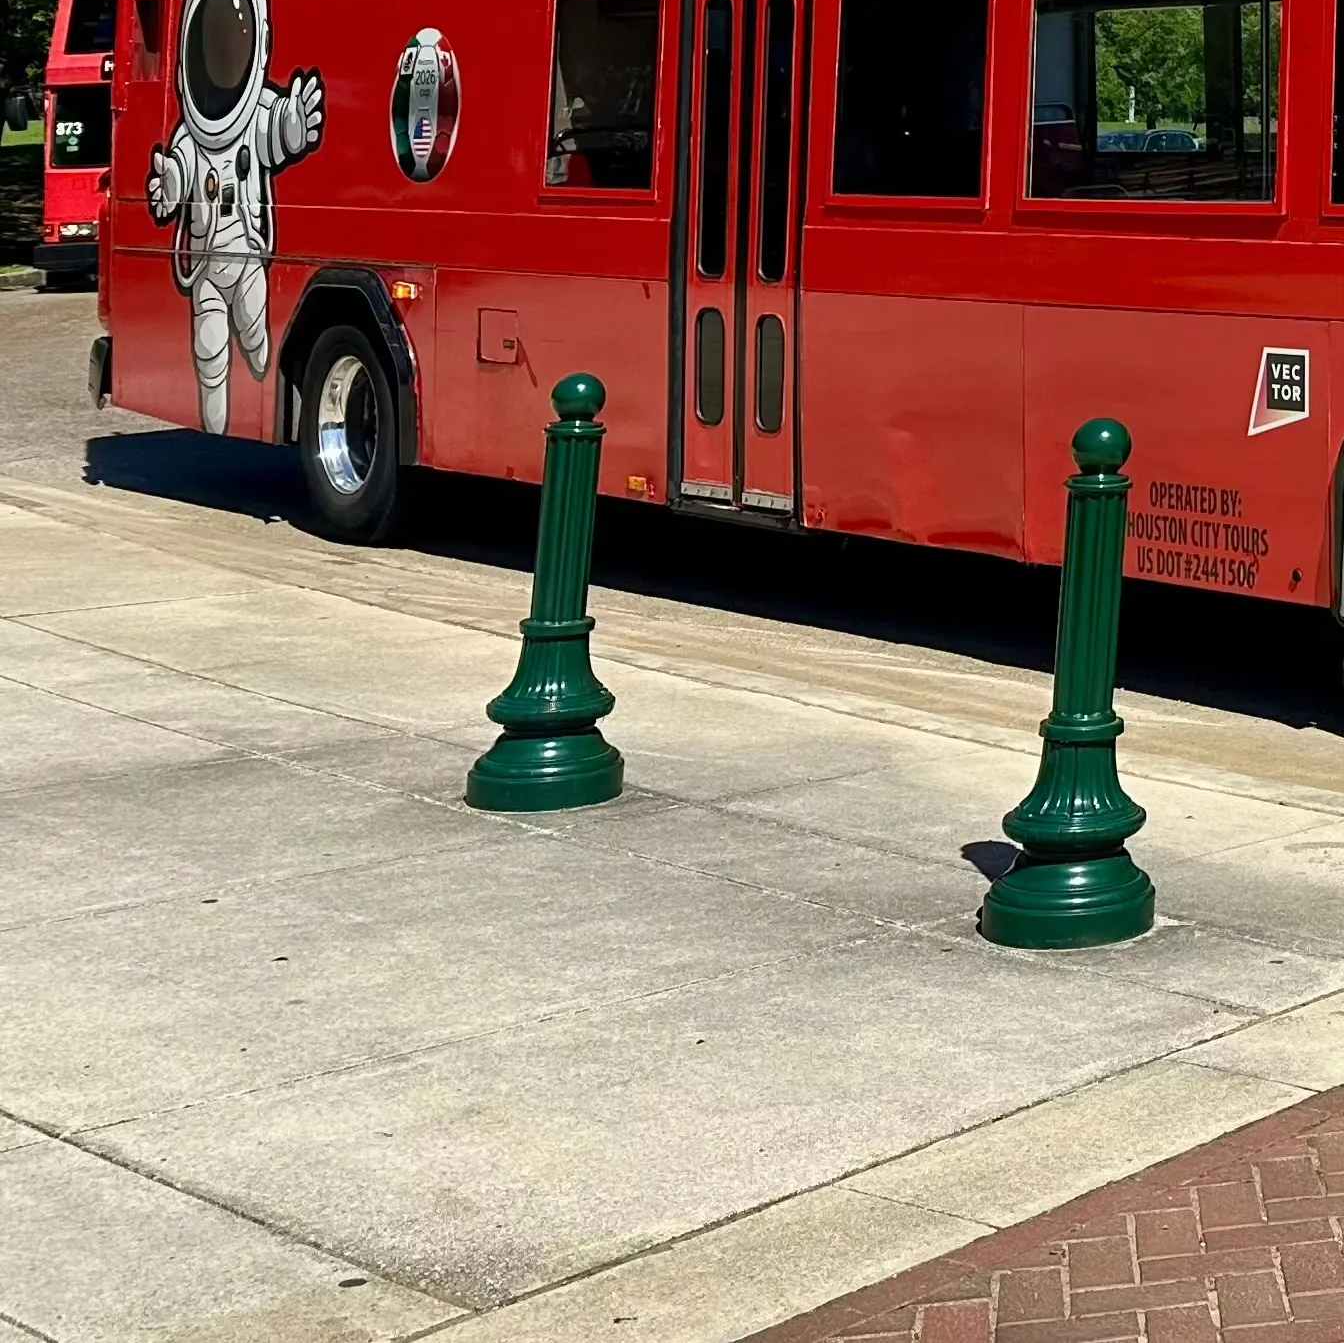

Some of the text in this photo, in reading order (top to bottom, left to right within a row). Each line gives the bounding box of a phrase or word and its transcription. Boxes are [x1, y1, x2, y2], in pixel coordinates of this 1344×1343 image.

[415, 69, 436, 86] 2026
[1271, 363, 1301, 381] VEC
[1271, 383, 1302, 402] TOR
[1149, 481, 1242, 518] OPERATED BY:
[1127, 510, 1269, 557] HOUSTON CITY TOURS
[1136, 546, 1256, 590] US DOT #2441506
